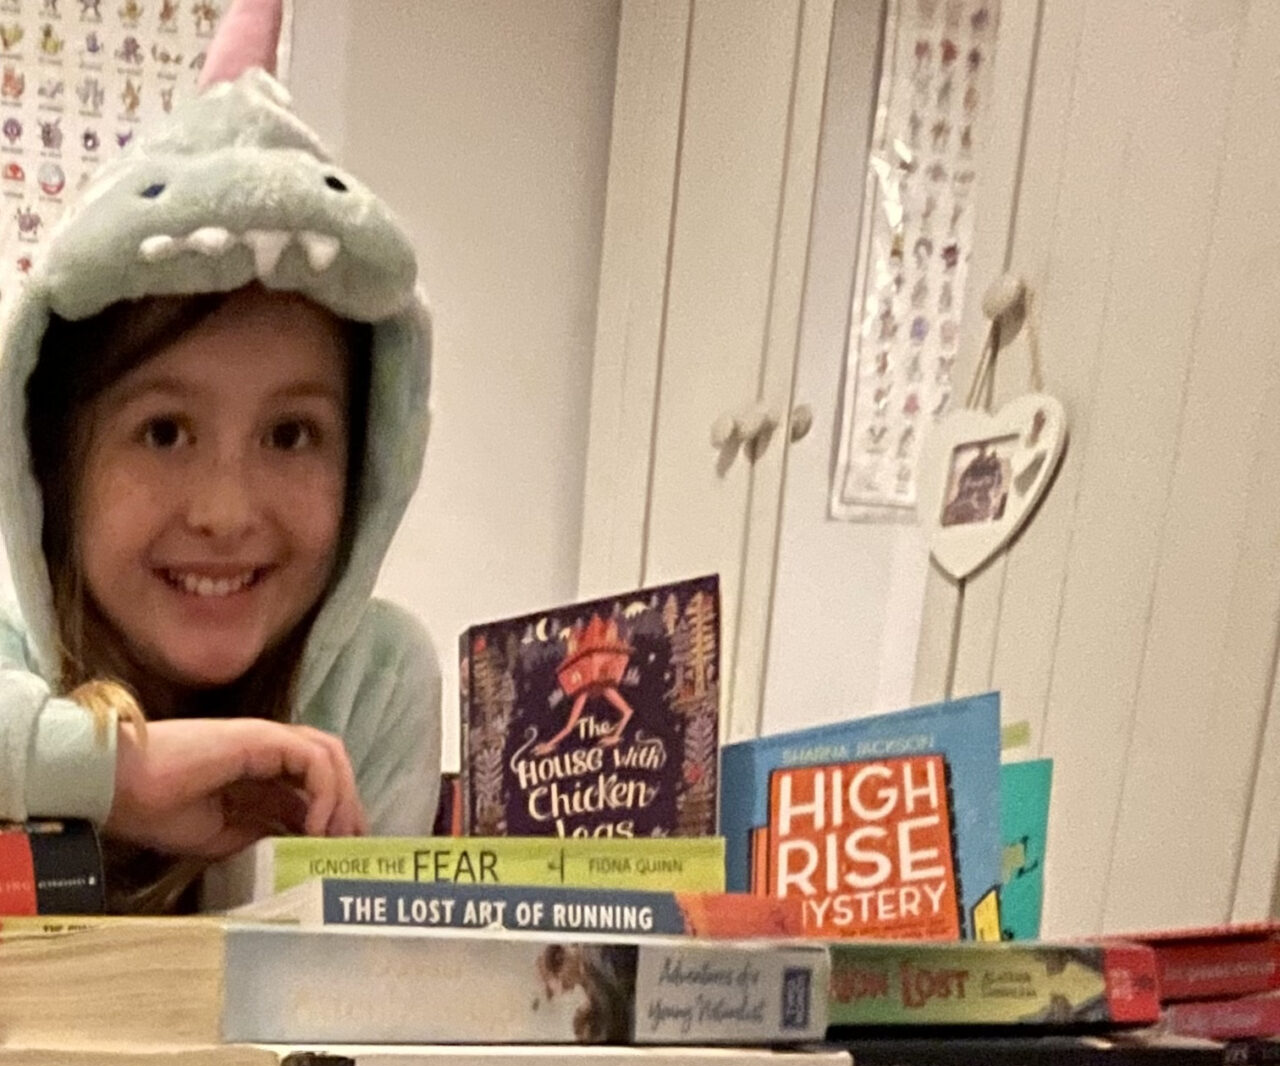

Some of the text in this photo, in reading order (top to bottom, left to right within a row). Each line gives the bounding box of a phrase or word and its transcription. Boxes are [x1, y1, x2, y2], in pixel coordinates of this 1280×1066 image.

[578, 717, 615, 741] The
[528, 774, 646, 821] Chicken
[777, 760, 940, 837] HIGH
[310, 850, 499, 883] IGNORE THE FEAR
[589, 856, 631, 875] FIONA
[776, 815, 947, 898] RISE
[339, 895, 654, 931] THE LOST ART OF RUNNING
